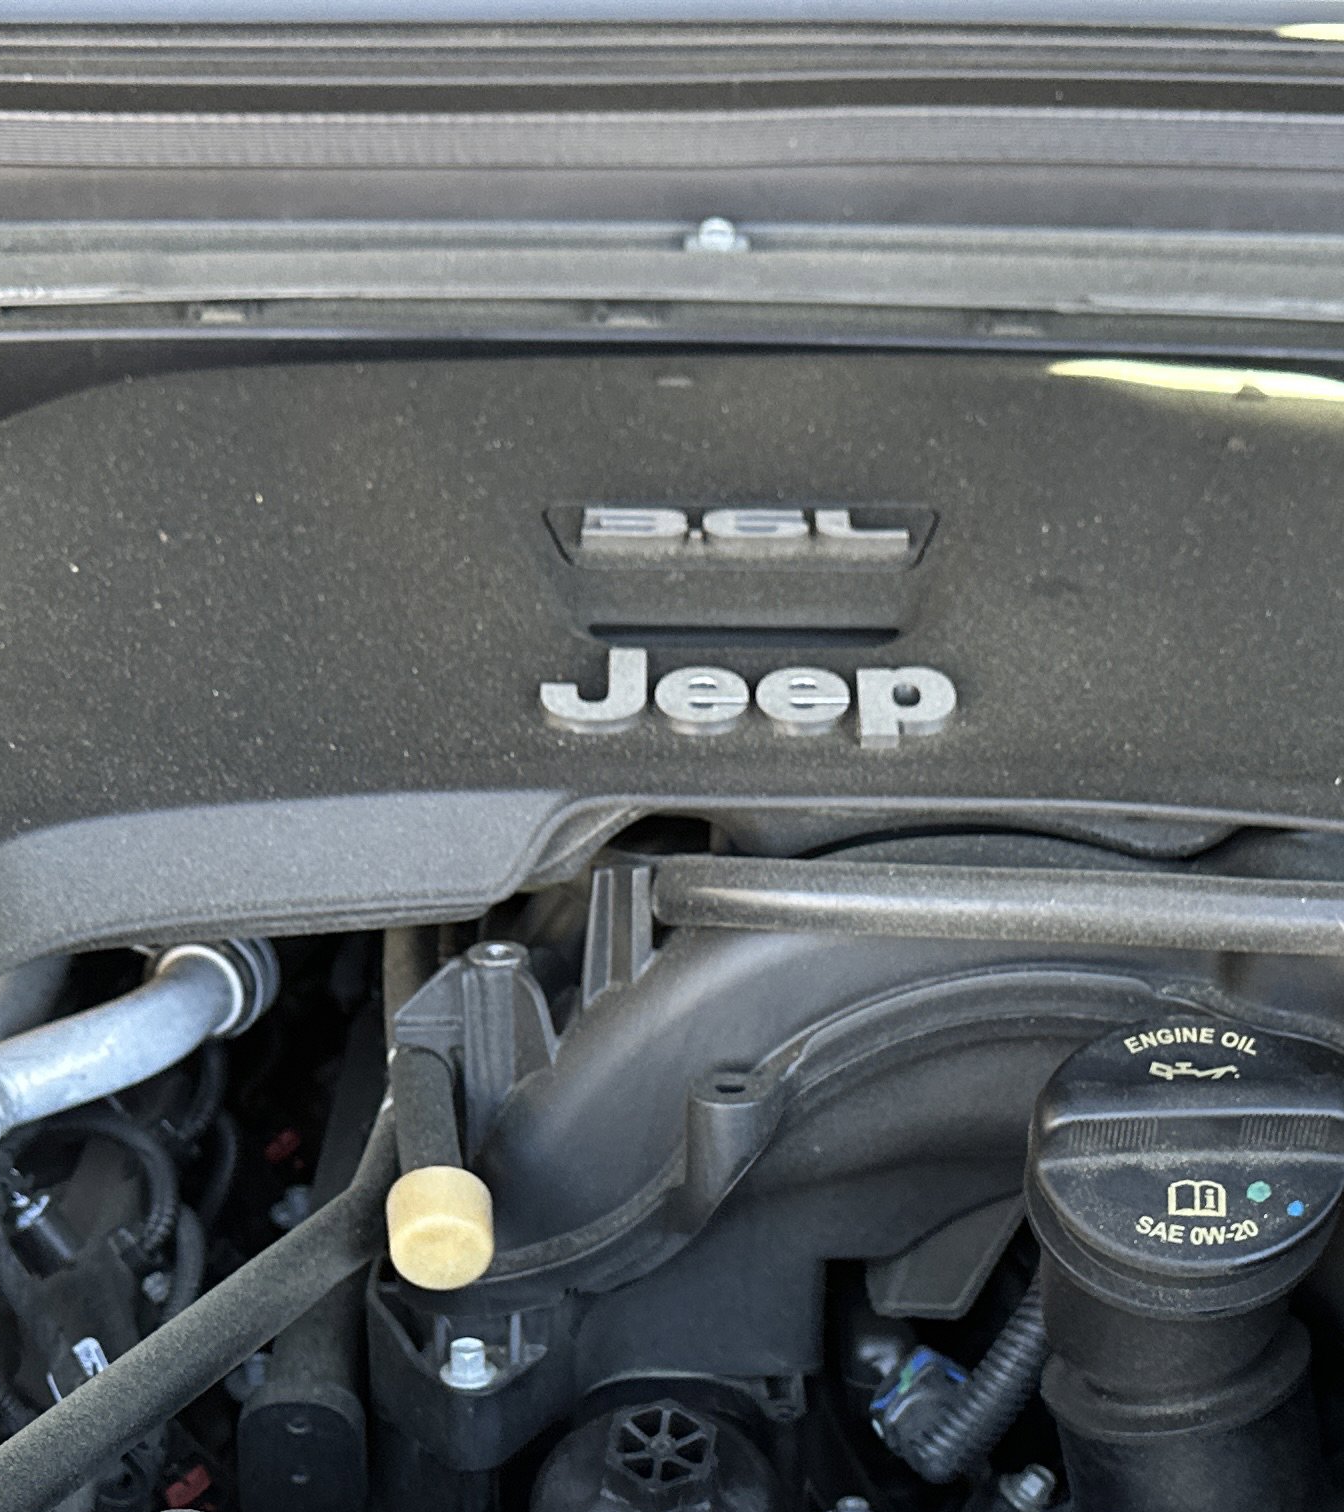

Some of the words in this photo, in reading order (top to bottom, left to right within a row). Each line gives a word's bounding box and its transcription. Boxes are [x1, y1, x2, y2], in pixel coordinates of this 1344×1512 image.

[540, 647, 958, 749] Jeep
[1123, 1027, 1216, 1055] ENGINE
[1220, 1030, 1258, 1057] OIL
[1135, 1215, 1184, 1244] SAE
[1189, 1219, 1259, 1246] 0W-20
